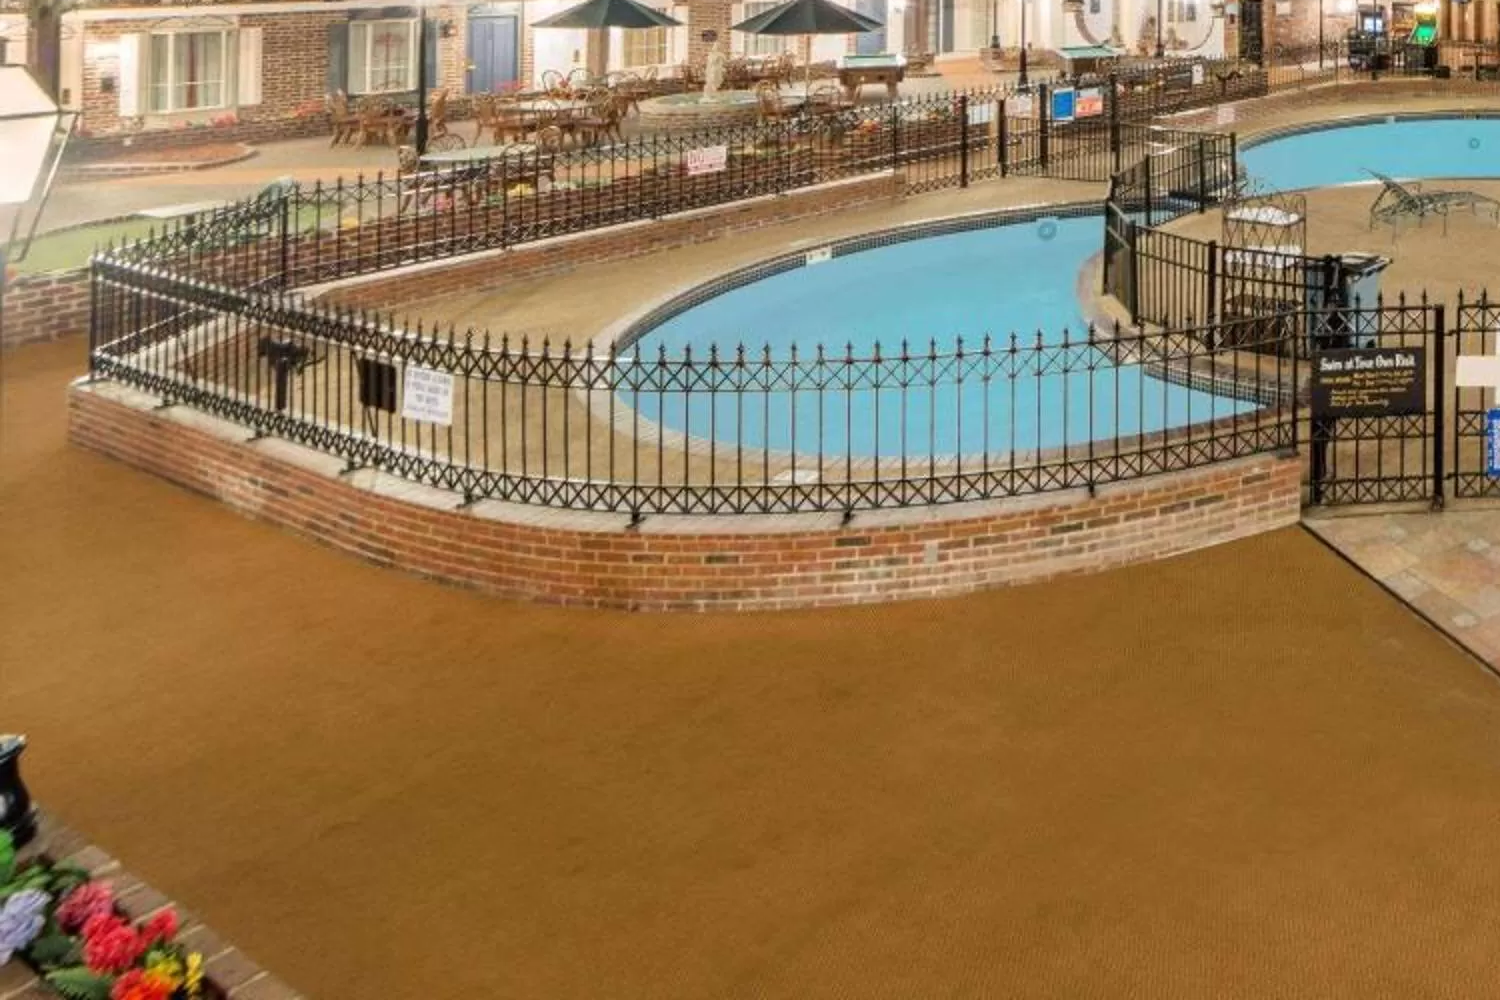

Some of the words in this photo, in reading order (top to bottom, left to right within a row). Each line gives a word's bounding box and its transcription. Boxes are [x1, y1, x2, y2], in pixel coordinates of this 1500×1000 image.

[1320, 358, 1343, 371] Swim
[1375, 354, 1394, 368] Own
[1395, 353, 1415, 367] Risk
